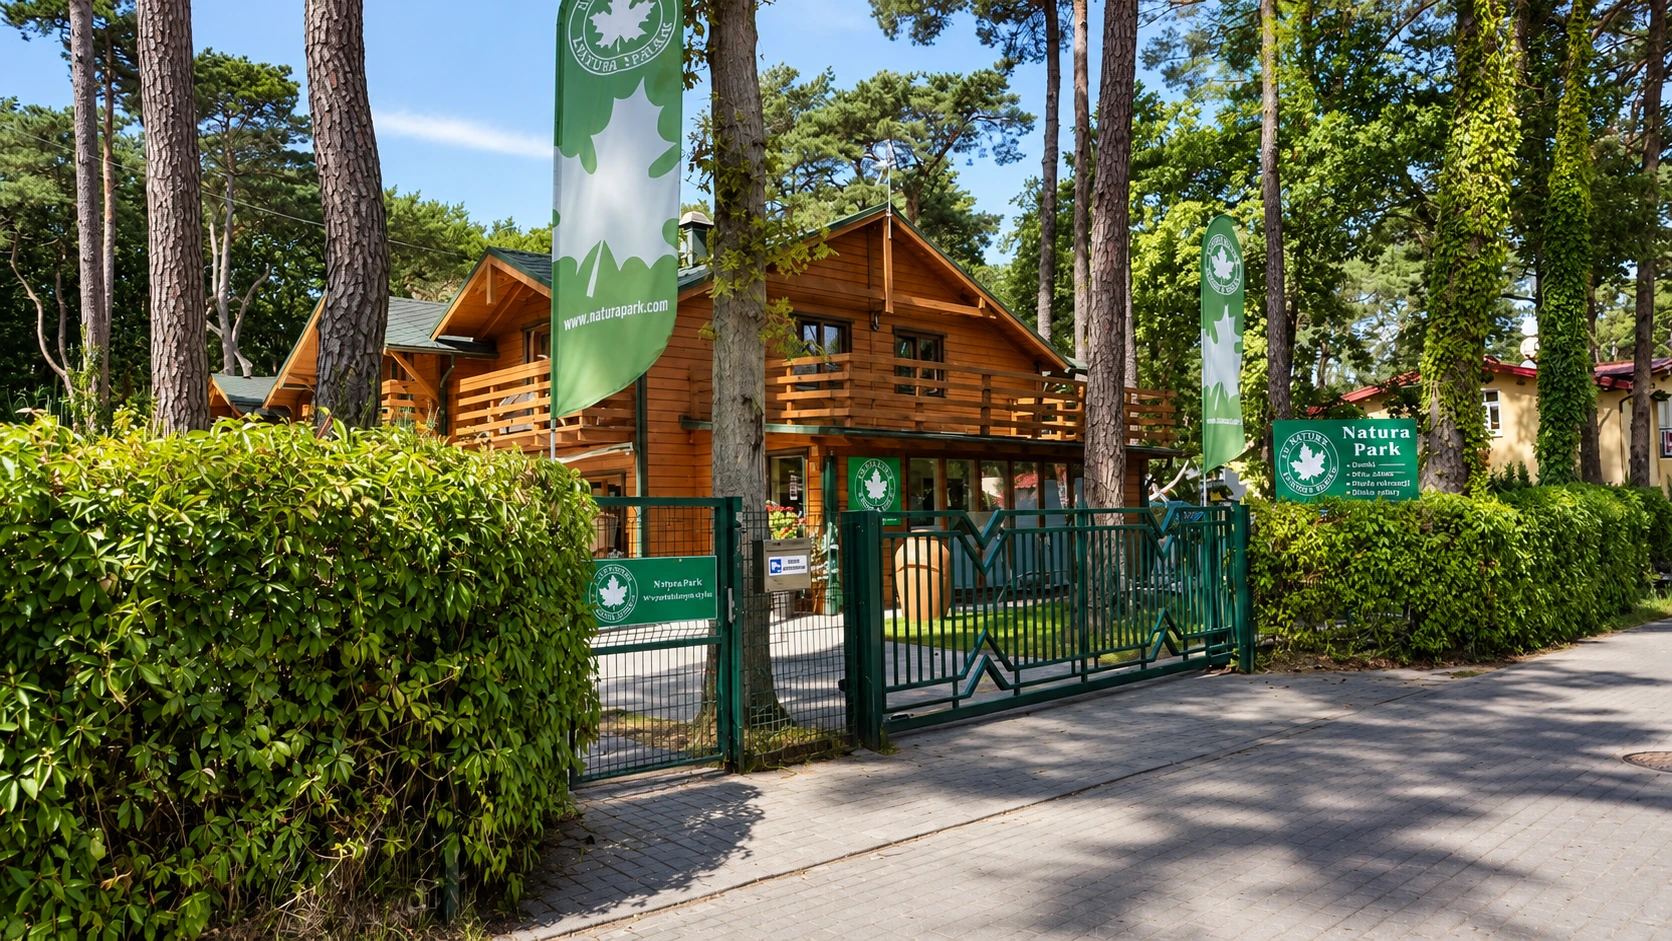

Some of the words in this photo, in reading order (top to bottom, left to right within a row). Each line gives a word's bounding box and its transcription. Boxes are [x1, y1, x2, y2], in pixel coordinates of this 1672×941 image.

[563, 299, 669, 331] www.naturapark.com
[1342, 425, 1411, 440] Natura
[1353, 441, 1402, 457] Park
[683, 578, 703, 587] Park
